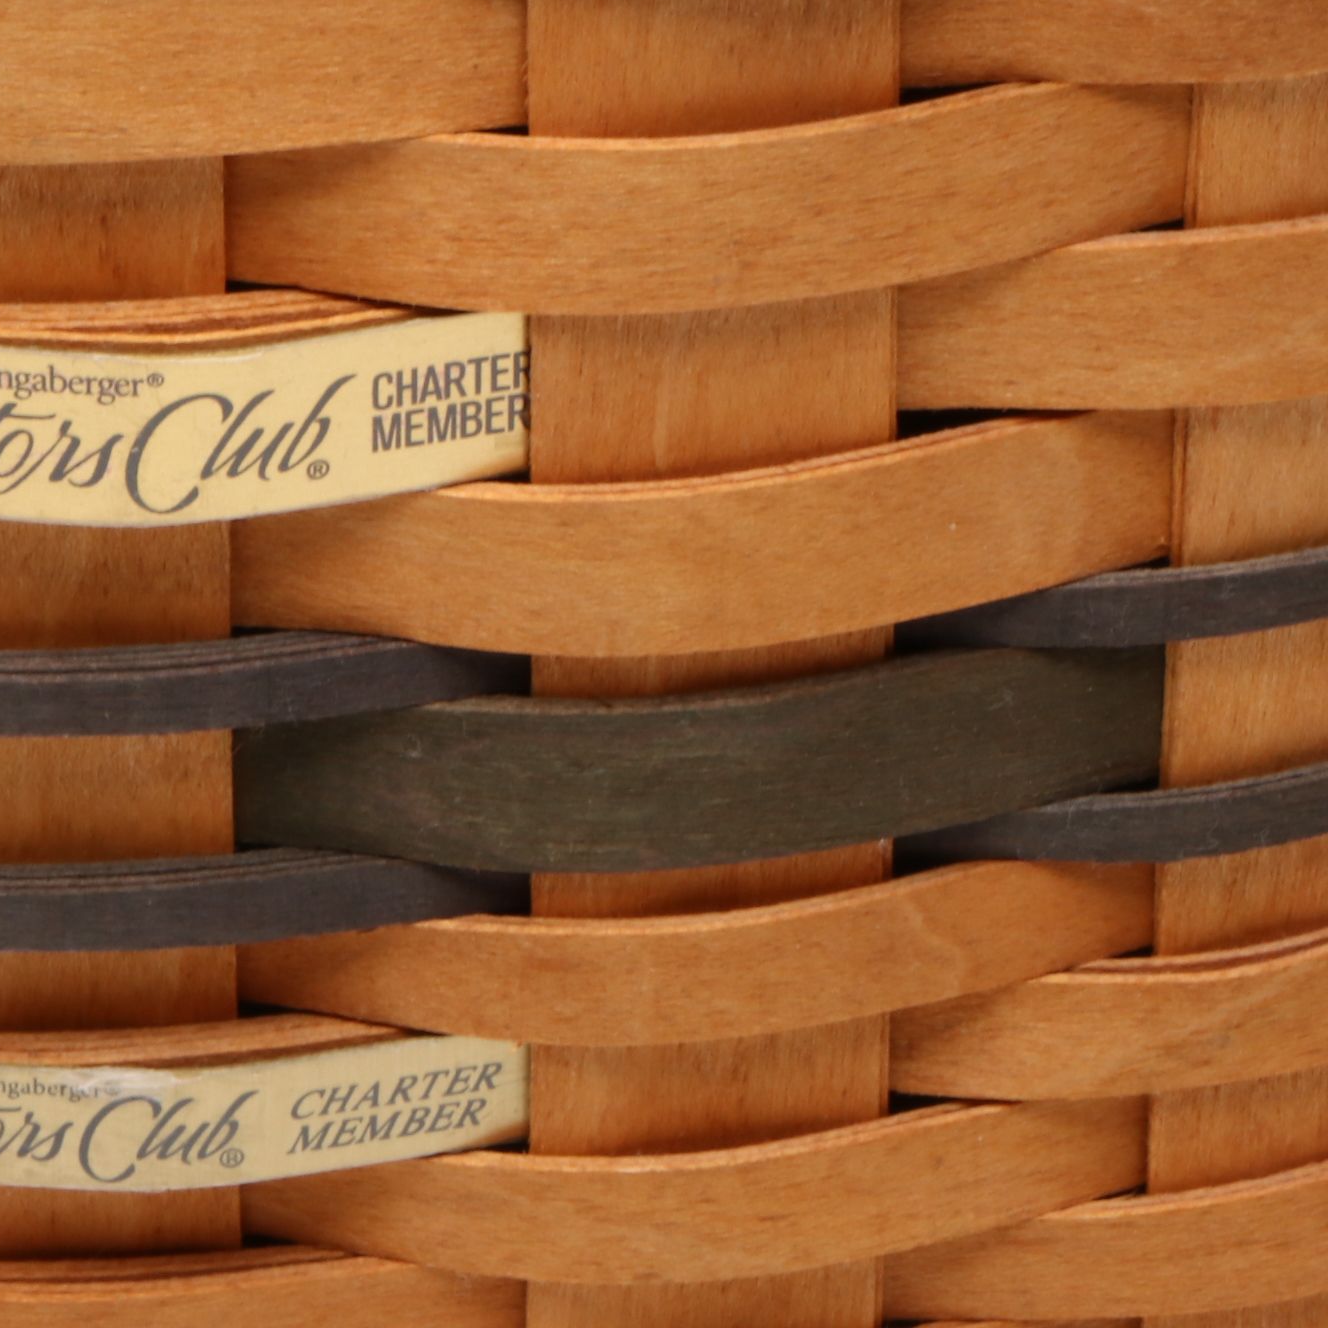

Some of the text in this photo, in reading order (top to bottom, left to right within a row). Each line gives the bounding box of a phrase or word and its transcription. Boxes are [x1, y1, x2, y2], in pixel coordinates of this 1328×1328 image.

[371, 350, 531, 411] CHARTER
[370, 391, 531, 454] MEMBER
[289, 1062, 502, 1121] CHARTER
[286, 1098, 486, 1154] MEMBER
